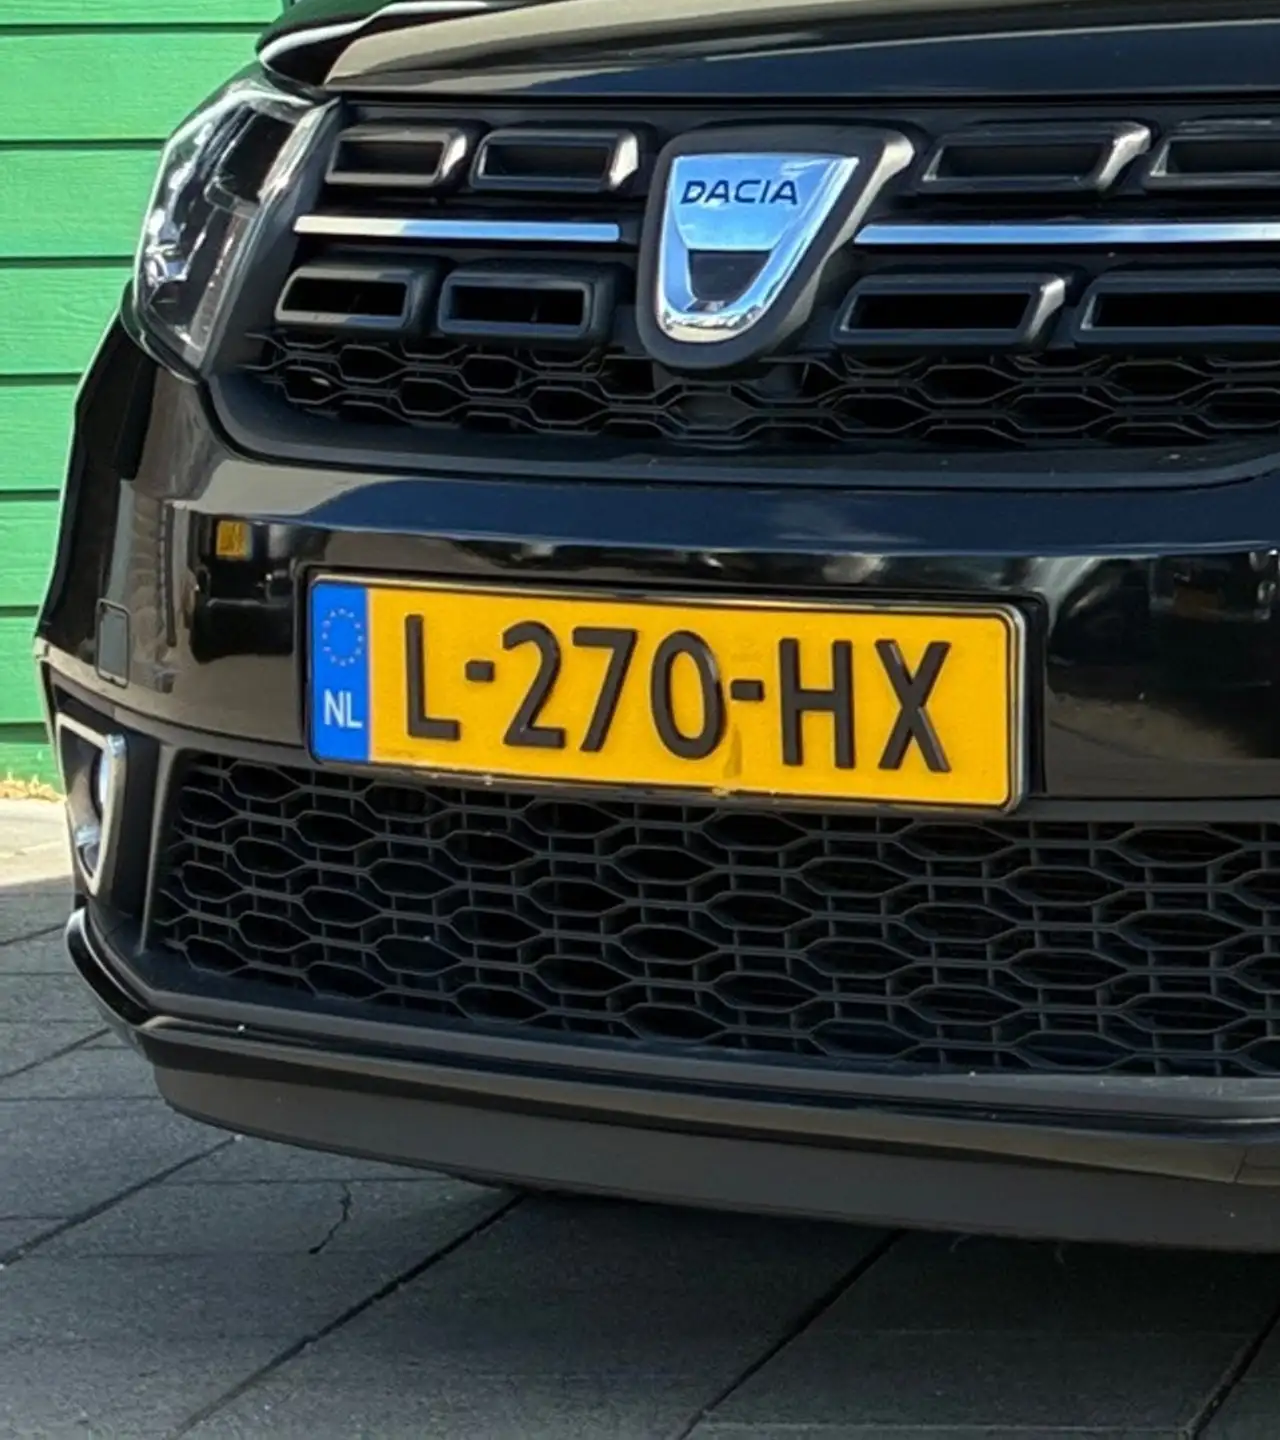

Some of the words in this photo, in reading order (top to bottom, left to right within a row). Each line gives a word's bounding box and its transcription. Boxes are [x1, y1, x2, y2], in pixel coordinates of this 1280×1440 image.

[681, 179, 798, 205] DACIA
[323, 689, 364, 729] NL
[404, 614, 952, 773] L-270-HX
